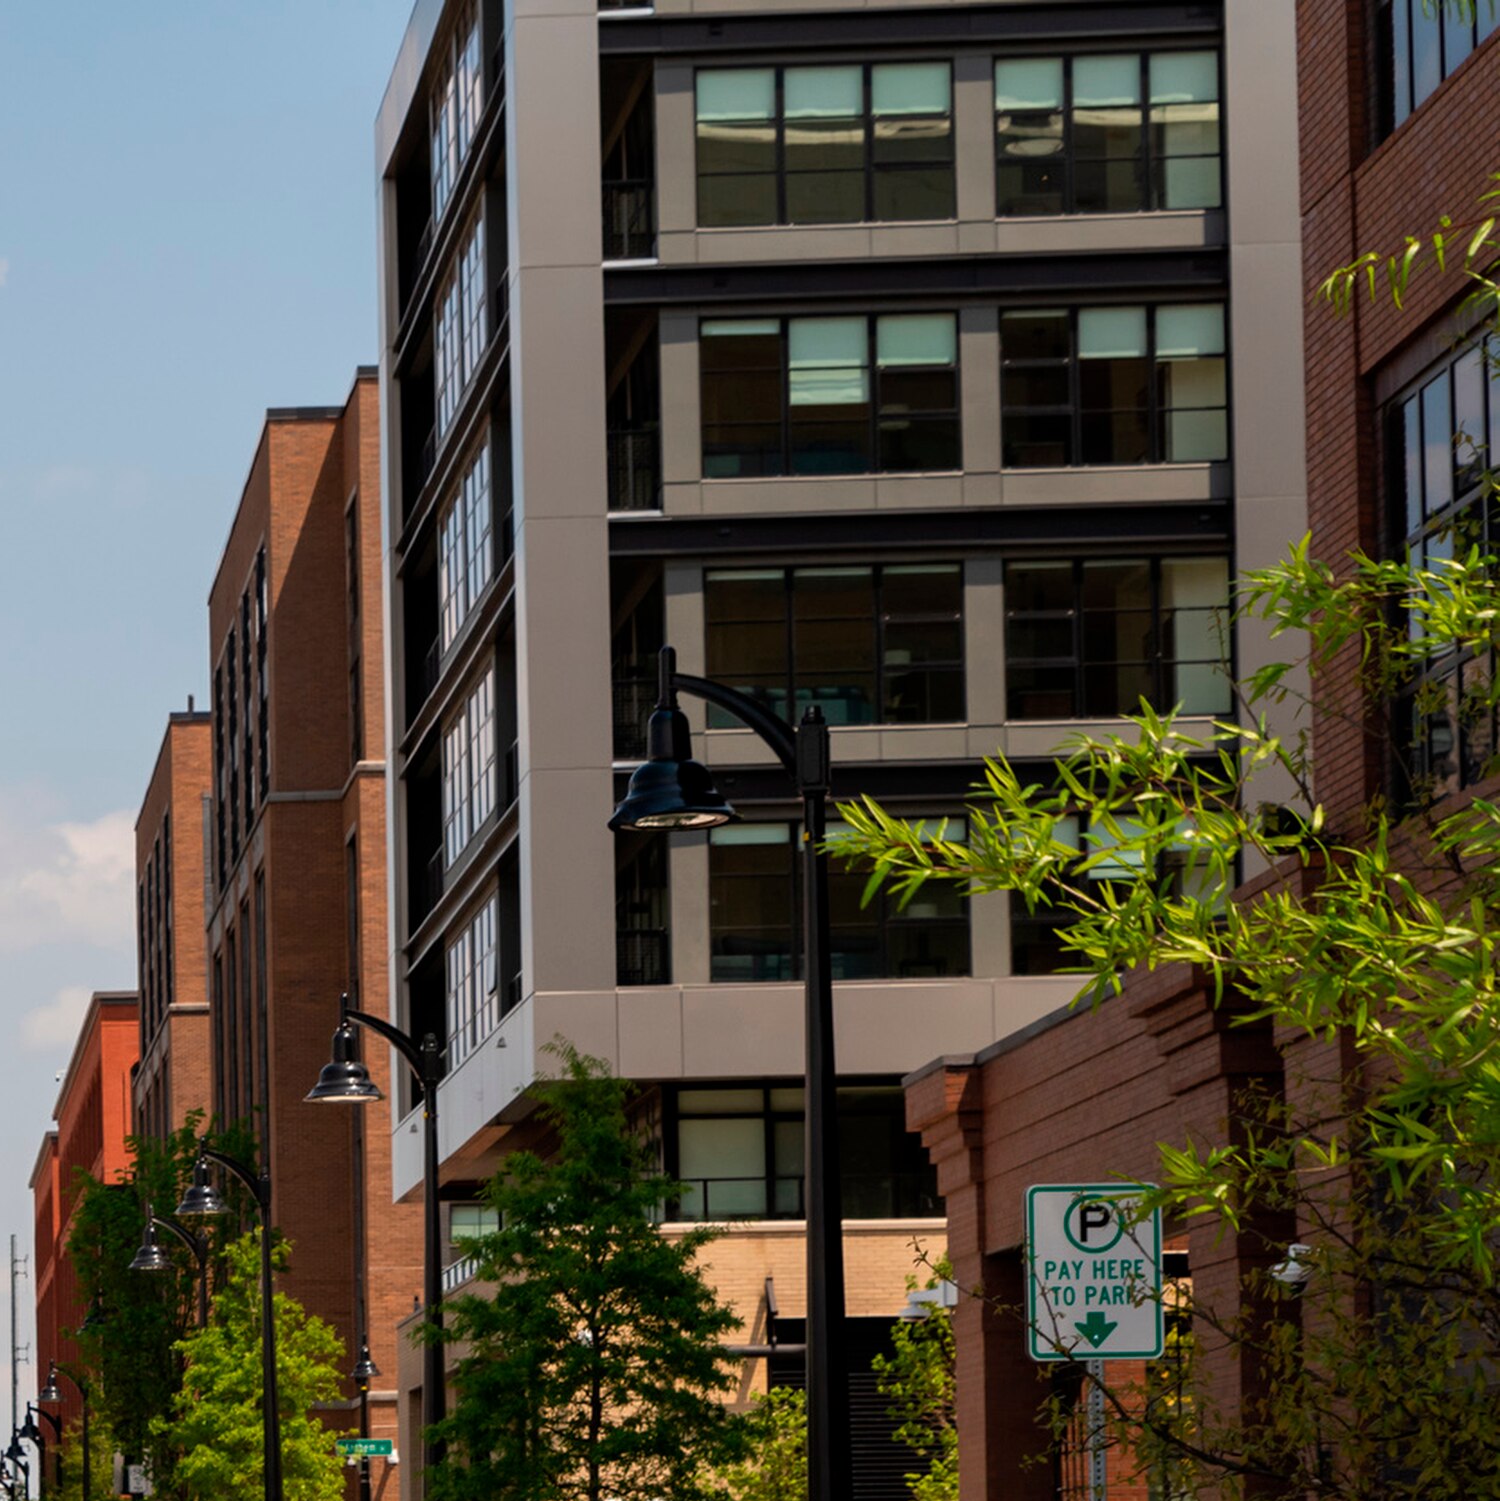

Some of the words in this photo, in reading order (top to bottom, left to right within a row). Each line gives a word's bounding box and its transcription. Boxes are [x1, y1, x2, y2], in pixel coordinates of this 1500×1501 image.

[1080, 1205, 1110, 1243] P
[1044, 1260, 1084, 1280] PAY
[1092, 1259, 1146, 1280] HERE
[1051, 1286, 1076, 1306] TO
